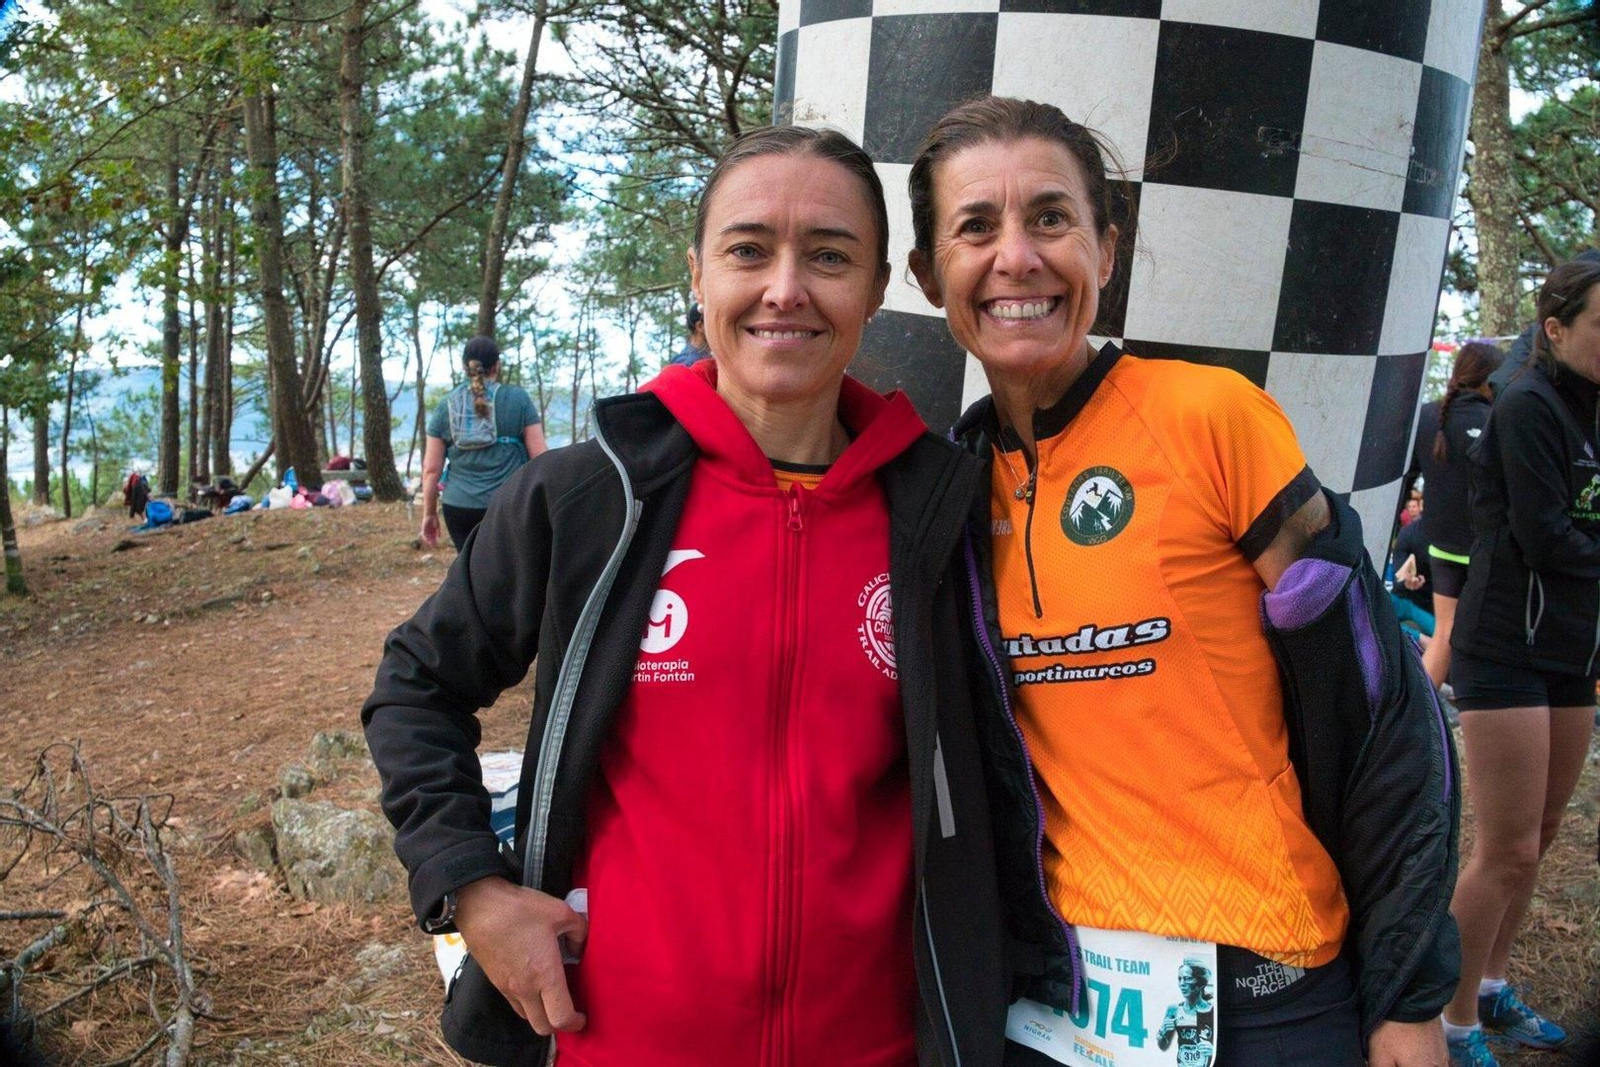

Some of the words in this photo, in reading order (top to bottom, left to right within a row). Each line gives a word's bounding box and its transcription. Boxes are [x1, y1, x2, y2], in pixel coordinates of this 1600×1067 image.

[1094, 467, 1115, 477] TRAIL
[1116, 475, 1132, 500] TEAM
[1089, 534, 1107, 545] VIGO
[857, 573, 890, 607] GALICI
[858, 623, 881, 669] TRAIL
[882, 667, 899, 680] AD
[633, 671, 651, 682] rtín
[653, 671, 695, 682] Fontán
[1084, 949, 1113, 971] TRAIL
[1115, 958, 1150, 976] TEAM
[1255, 961, 1281, 975] THE
[1235, 969, 1284, 988] NORTH
[1252, 979, 1286, 998] FACE
[1053, 975, 1148, 1048] 074
